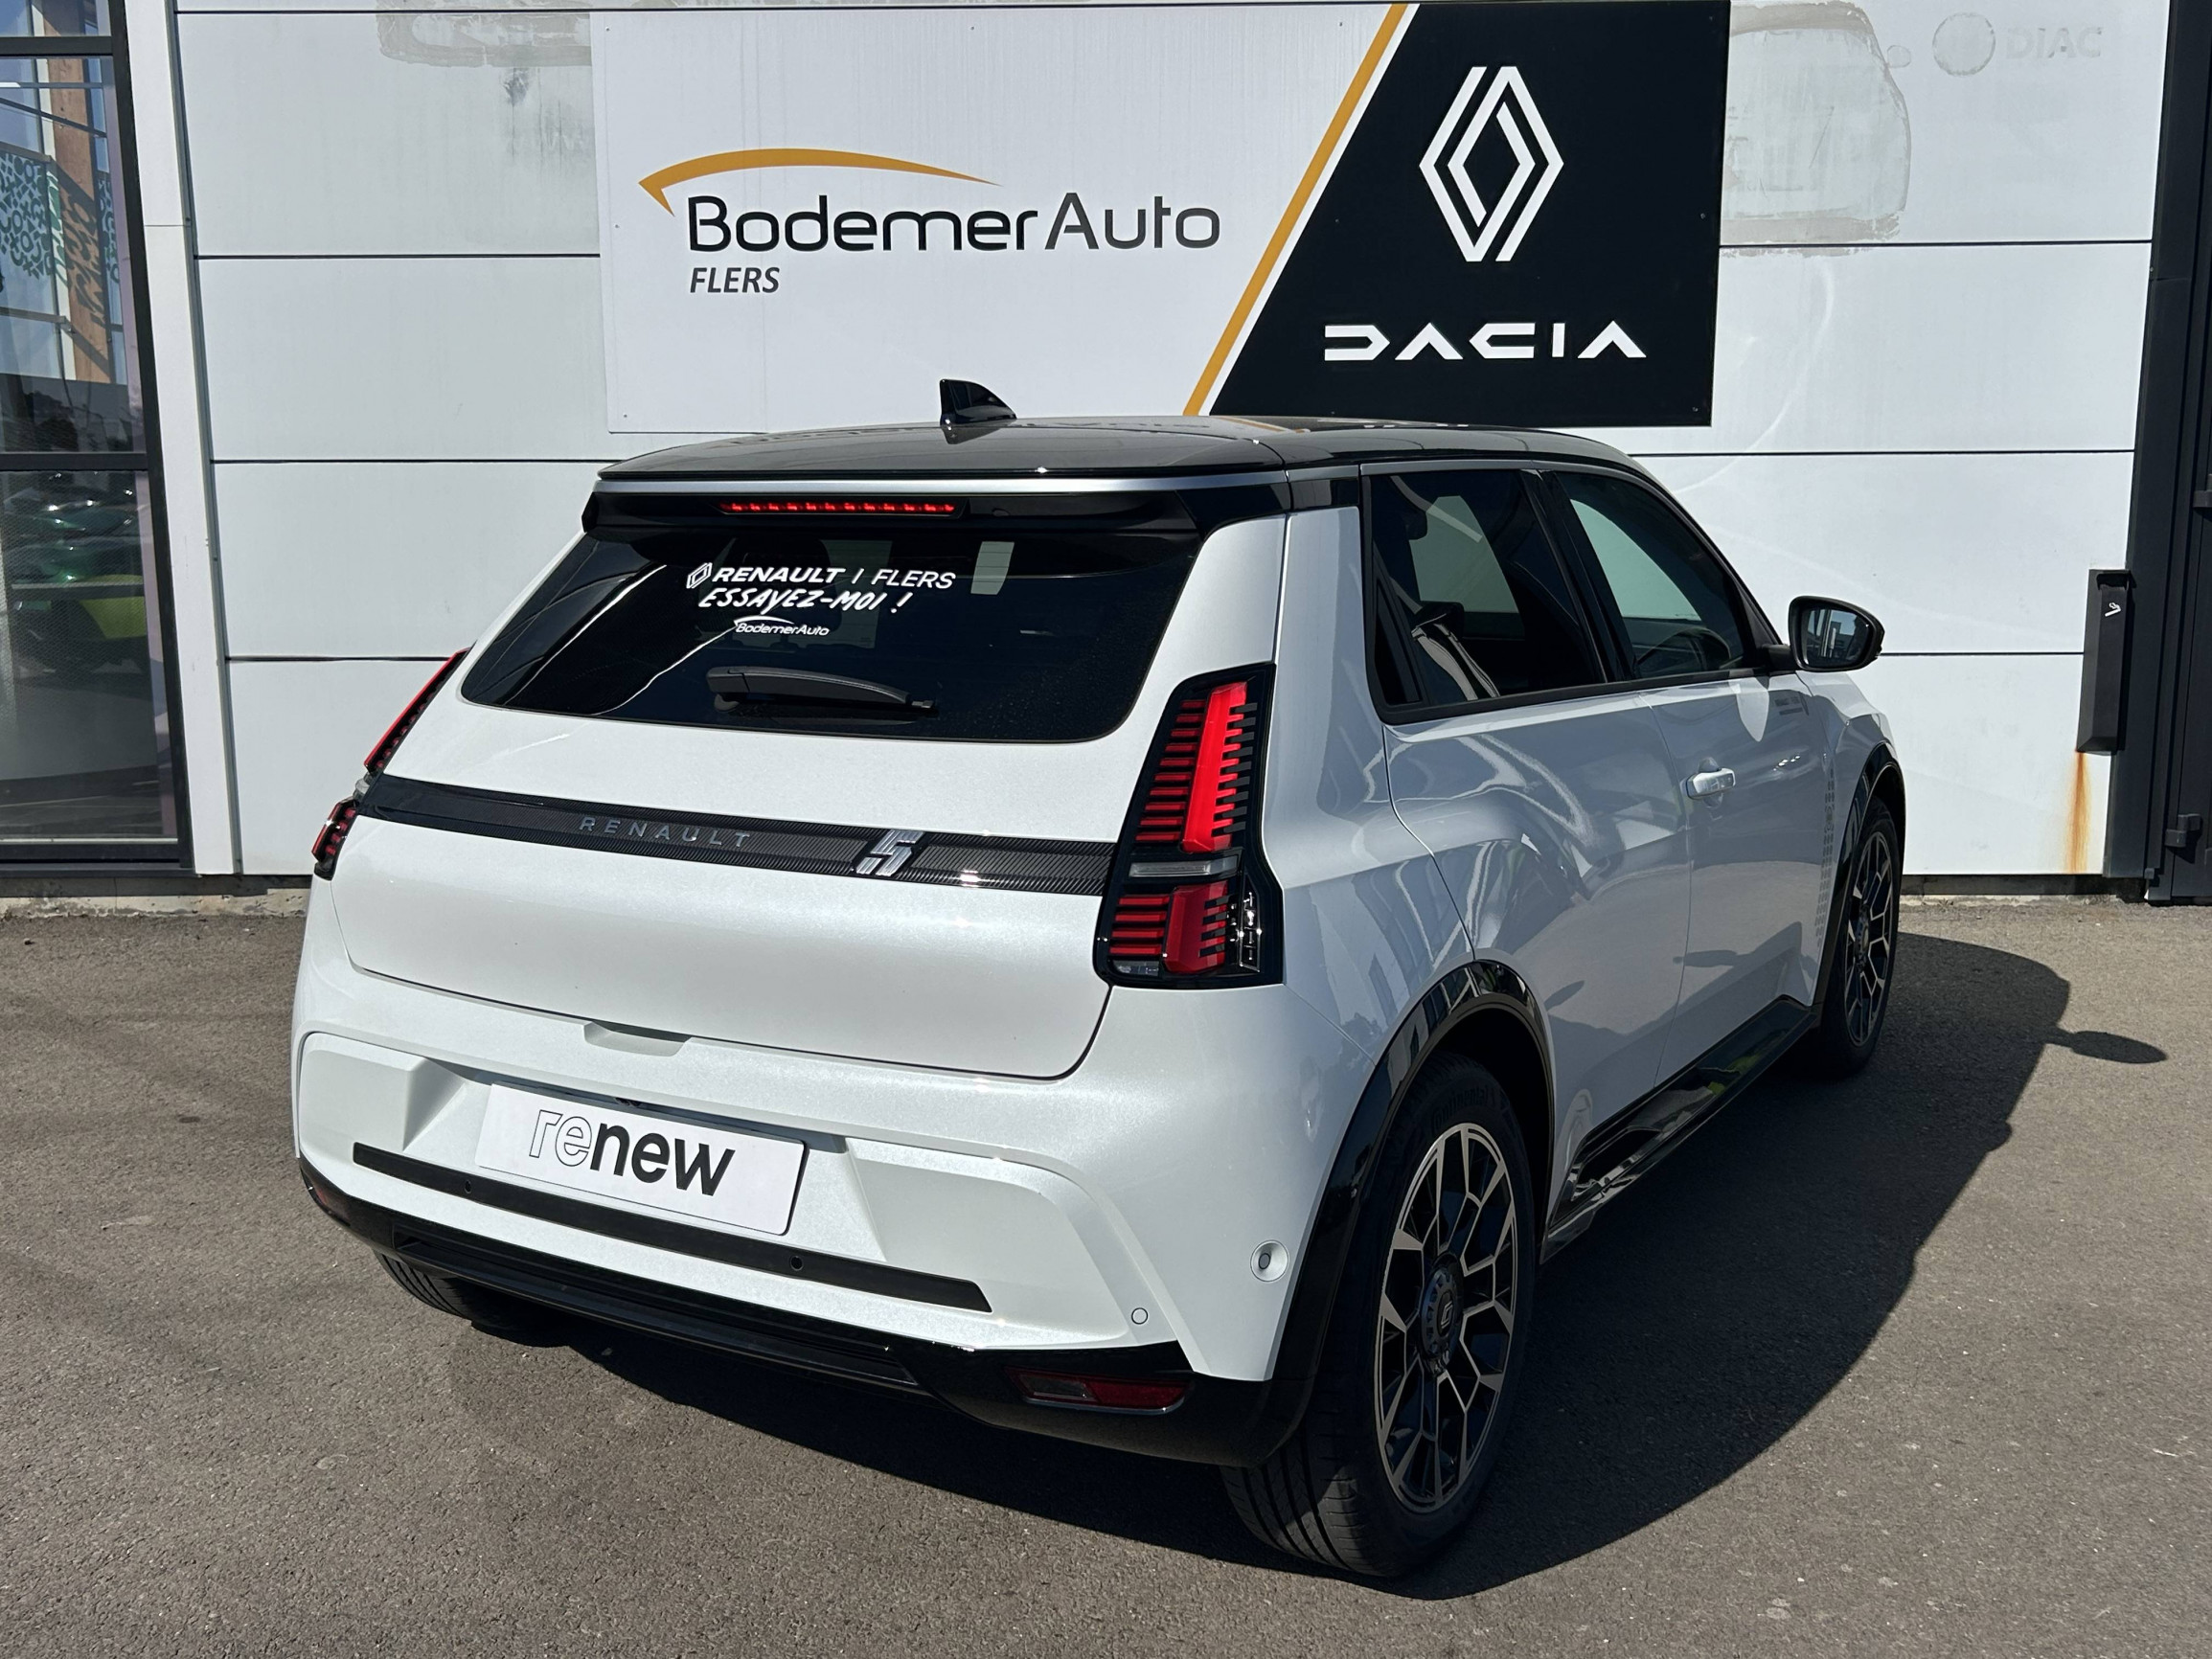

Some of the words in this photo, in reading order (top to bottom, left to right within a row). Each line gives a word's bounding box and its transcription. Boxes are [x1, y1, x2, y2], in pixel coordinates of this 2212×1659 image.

[2005, 27, 2104, 59] DIAC
[688, 193, 1220, 253] BodemerAuto
[690, 267, 780, 293] FLERS
[1324, 320, 1646, 362] DACIA
[712, 567, 846, 583] RENAULT
[872, 569, 956, 589] FLERS
[698, 587, 887, 615] ESSAYEZ-MOI
[736, 623, 830, 636] BodemerAuto
[579, 816, 751, 848] RENAULT
[855, 830, 924, 876] 5
[529, 1109, 736, 1196] renew
